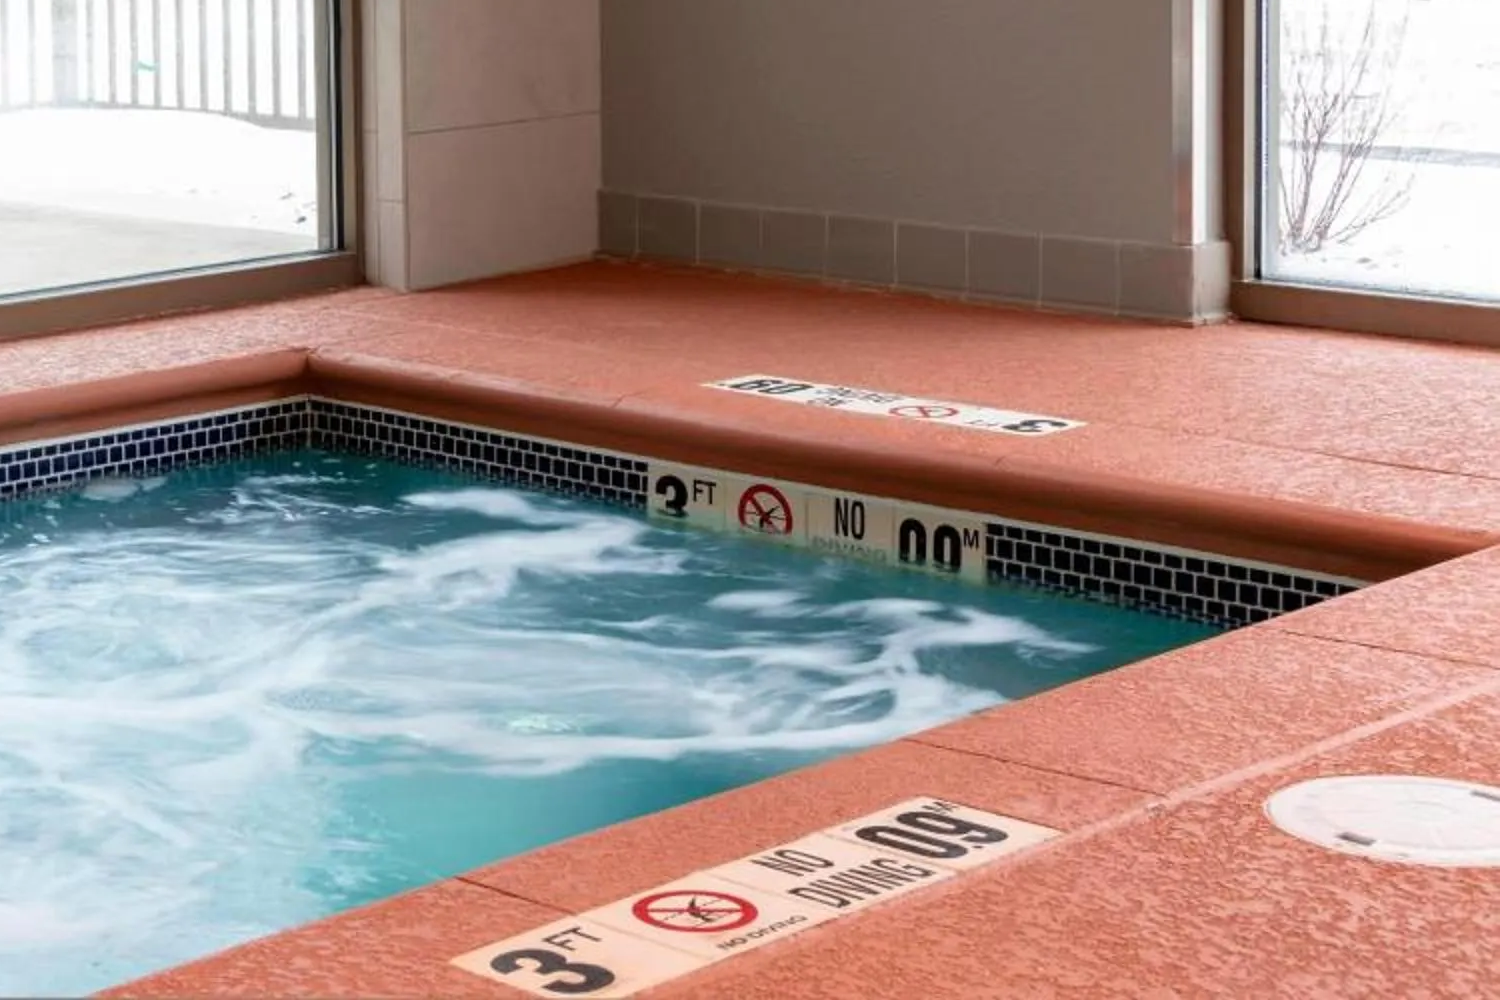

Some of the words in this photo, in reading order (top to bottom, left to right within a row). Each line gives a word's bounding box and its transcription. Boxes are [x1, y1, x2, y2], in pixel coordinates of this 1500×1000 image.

[655, 474, 688, 516] 3
[693, 479, 717, 506] FT
[835, 496, 866, 541] NO
[963, 528, 980, 549] M
[854, 810, 1010, 860] 0.9
[750, 848, 834, 878] NO
[789, 856, 938, 907] DIVING
[542, 925, 603, 952] FT
[715, 936, 748, 951] NO
[746, 914, 809, 940] DIVING
[490, 948, 616, 994] 3
